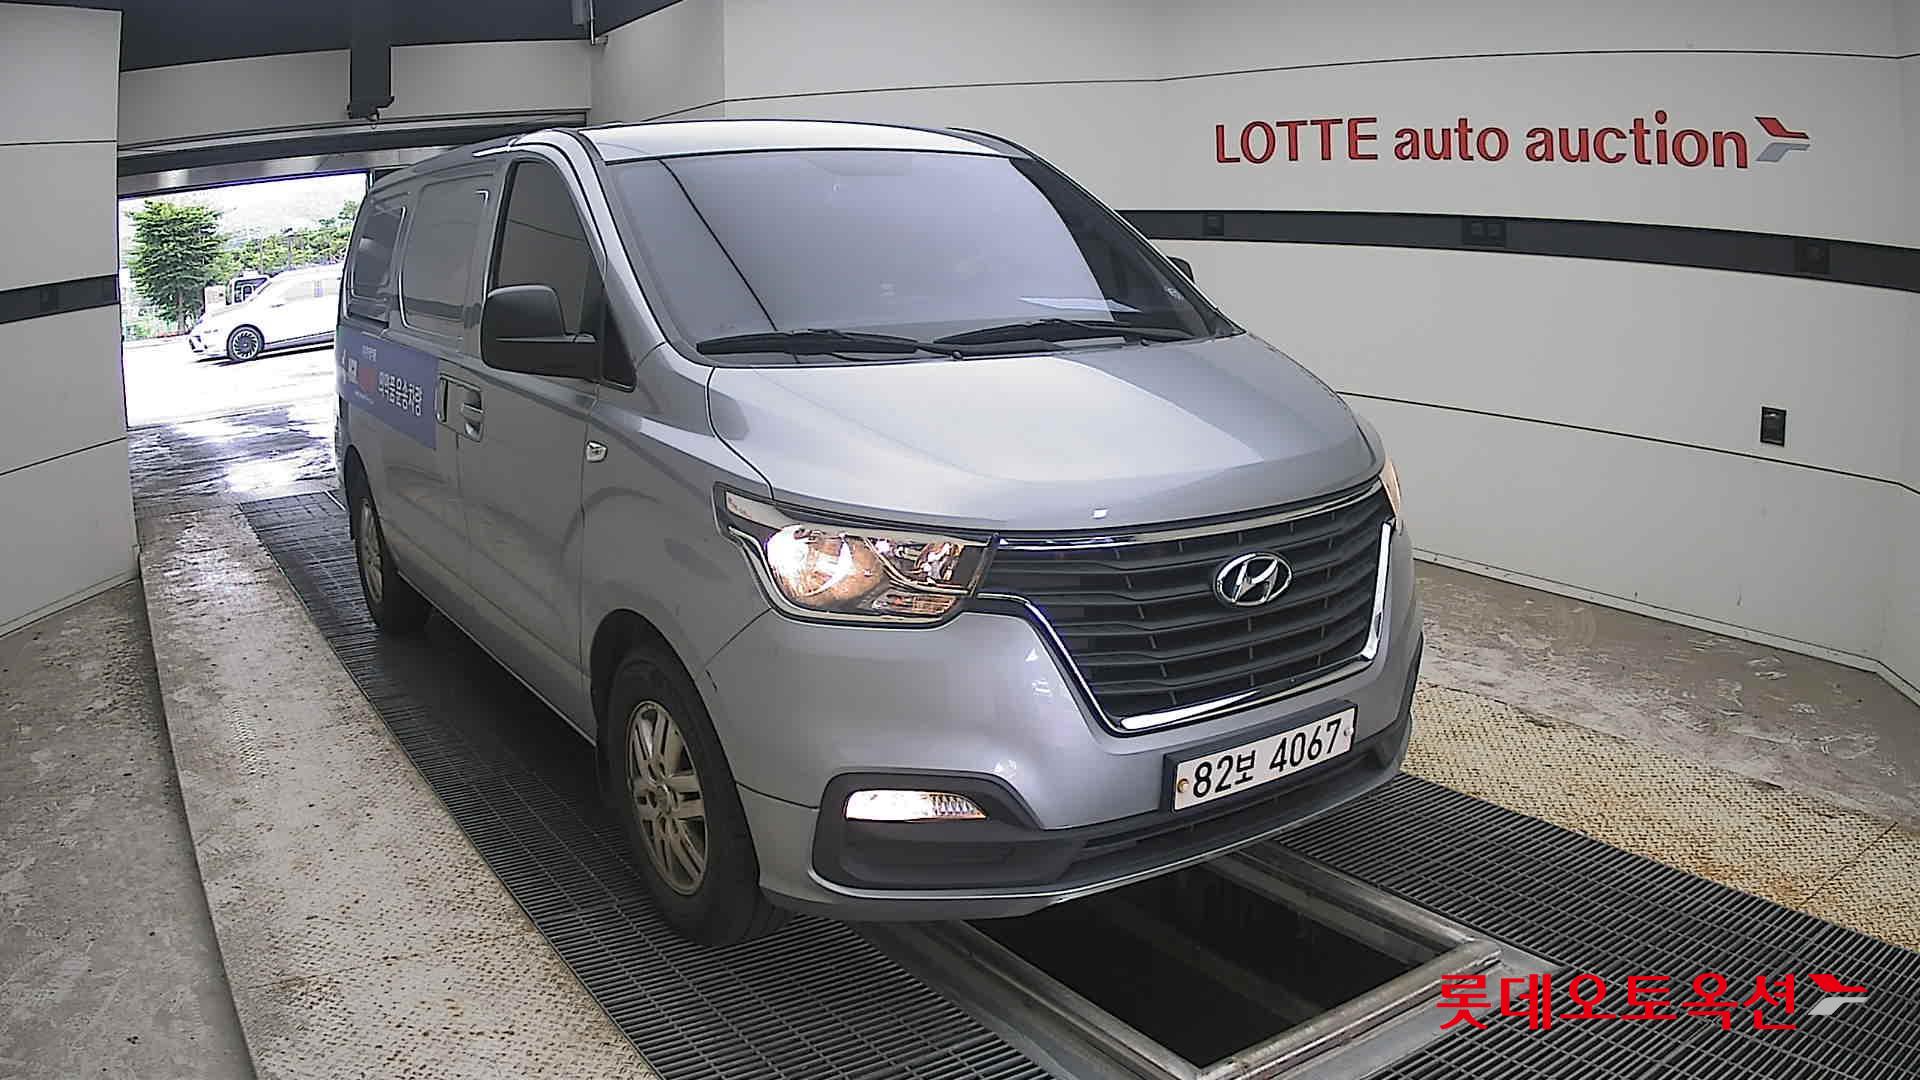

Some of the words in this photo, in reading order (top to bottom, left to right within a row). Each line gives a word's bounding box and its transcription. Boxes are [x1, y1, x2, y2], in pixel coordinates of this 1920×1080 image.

[1215, 117, 1378, 164] LOTTE
[1394, 118, 1511, 162] auto
[1525, 110, 1749, 169] auction
[1192, 749, 1257, 799] 82보
[1268, 717, 1343, 773] 4067
